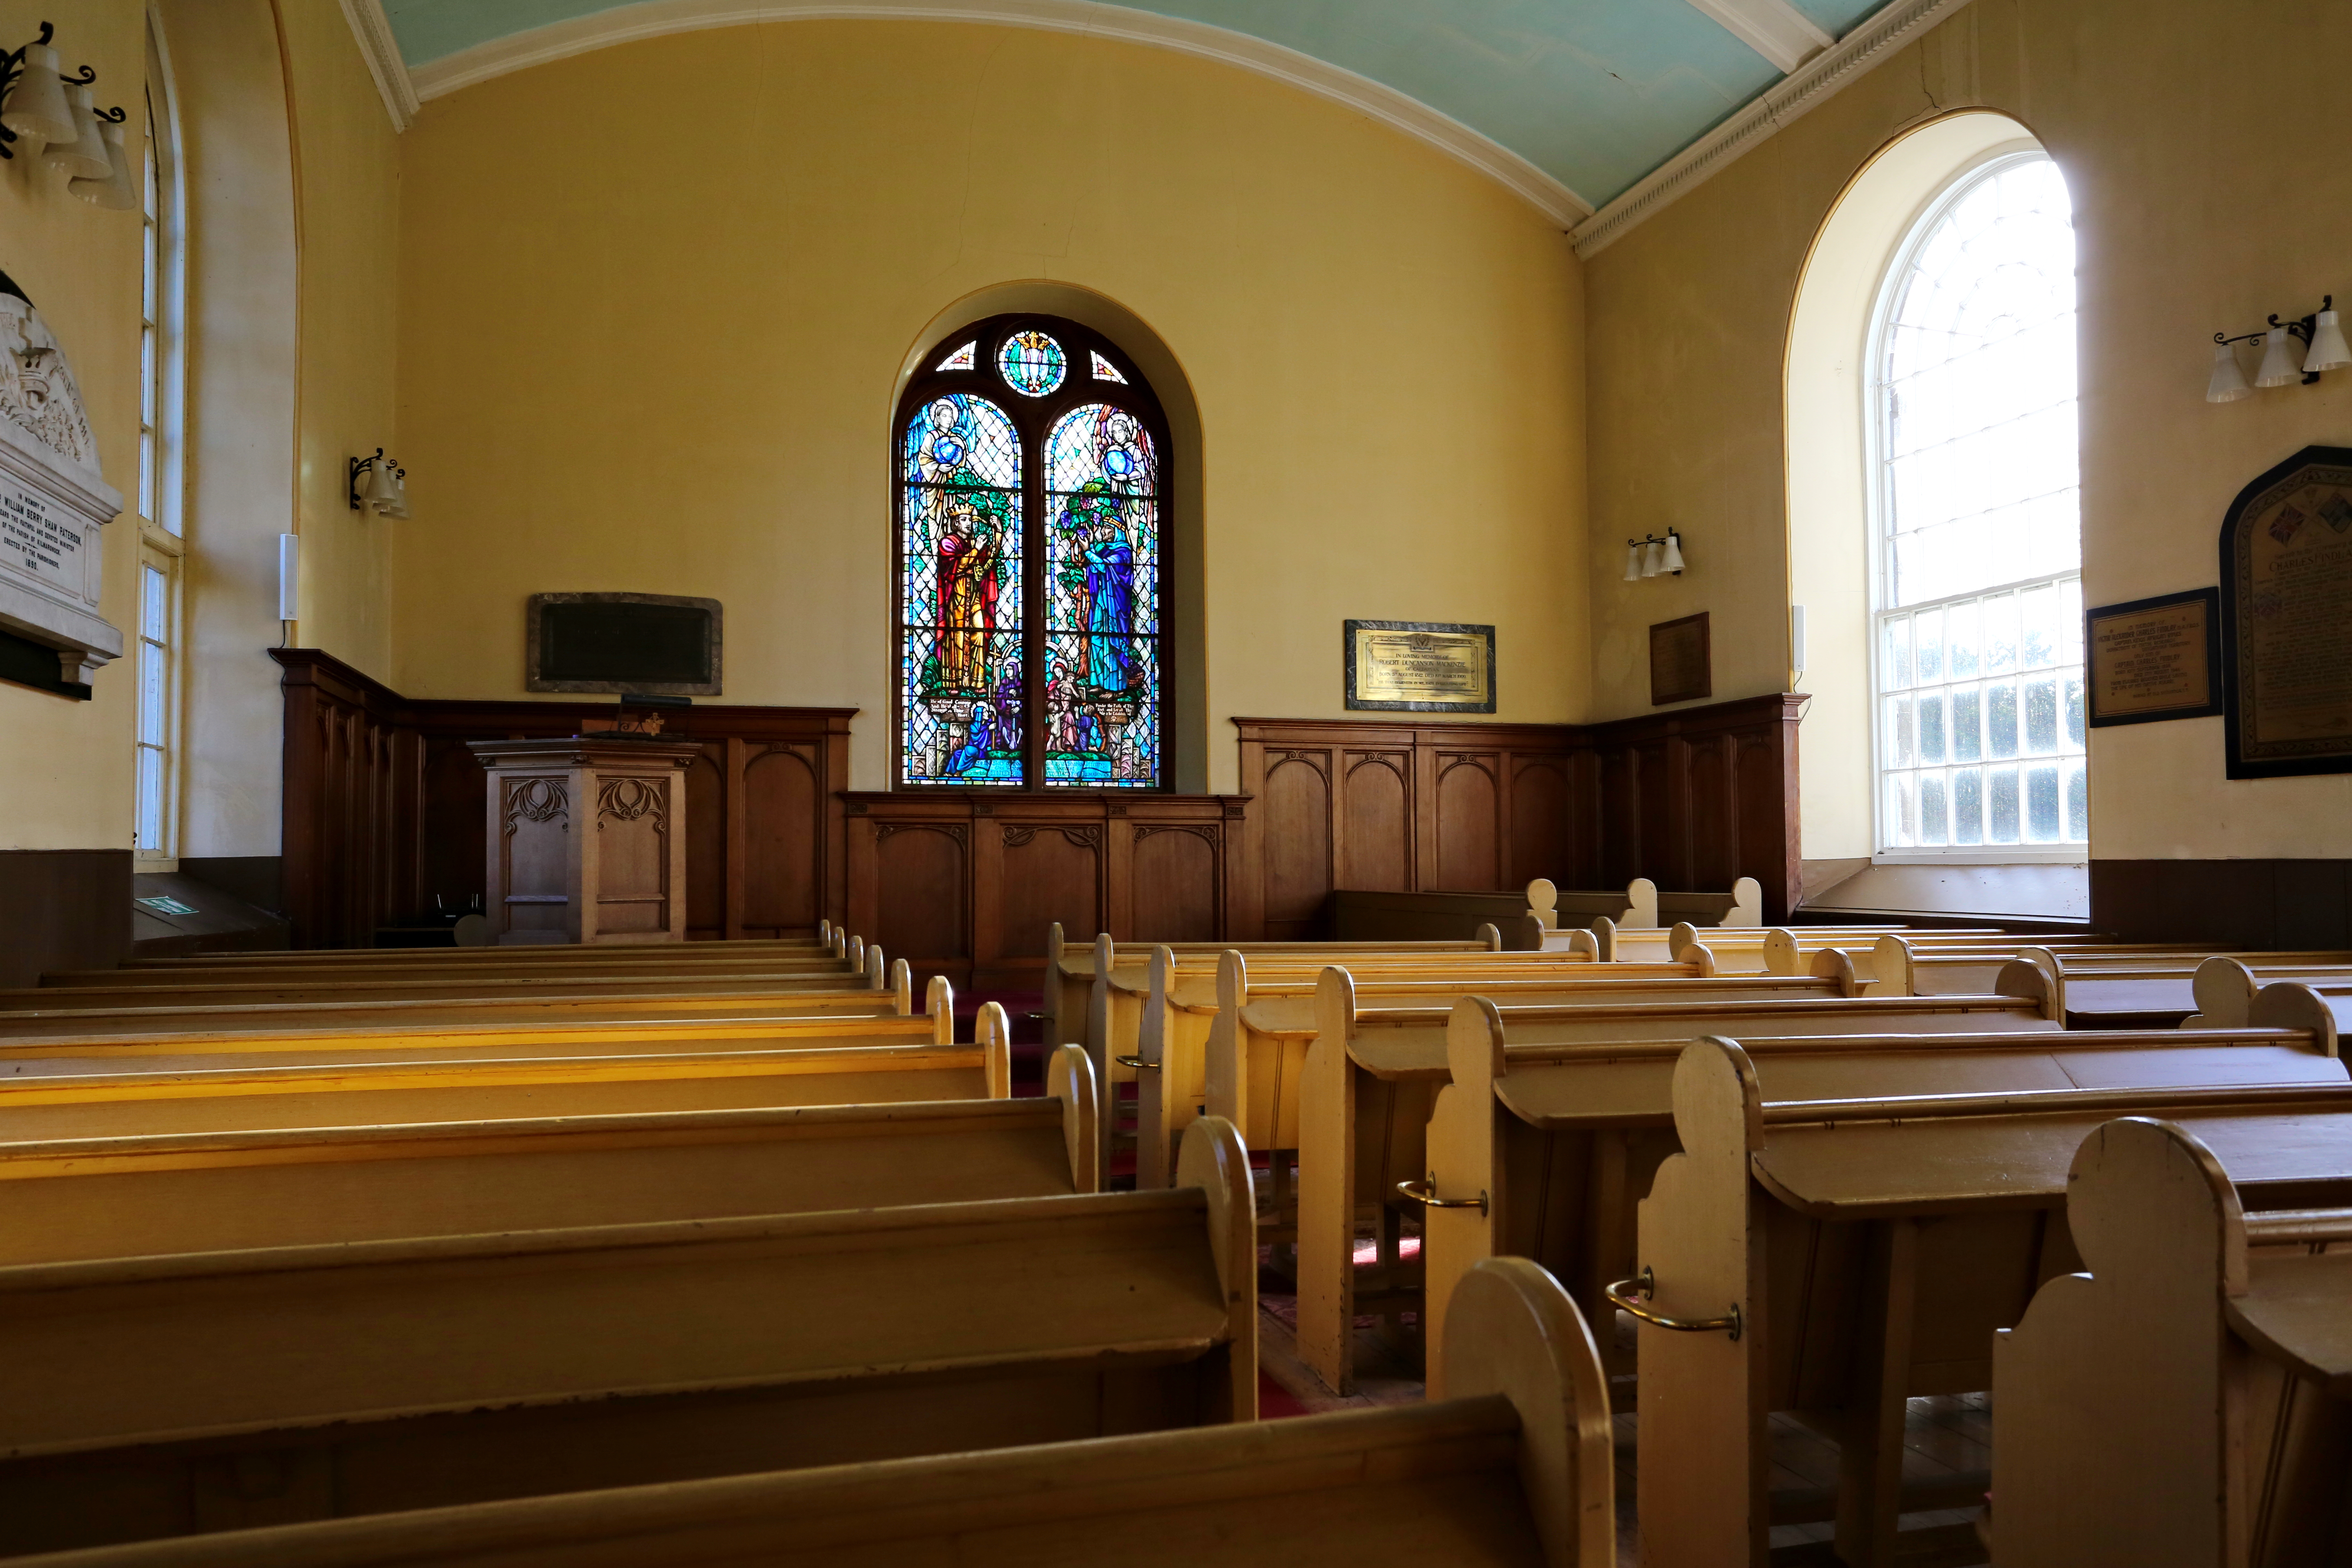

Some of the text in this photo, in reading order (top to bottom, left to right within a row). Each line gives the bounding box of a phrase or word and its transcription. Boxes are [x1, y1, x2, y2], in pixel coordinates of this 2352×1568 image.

[25, 497, 40, 509] MEMORY
[4, 497, 24, 515] WILLIAM
[27, 509, 42, 525] BERRY
[45, 519, 58, 532] SHAW
[60, 526, 82, 546] PATERSON,
[0, 509, 9, 518] EARS
[20, 519, 35, 532] FAITHFUL
[45, 532, 58, 543] DEVOTED
[60, 540, 74, 552] MINISTER
[17, 529, 29, 539] PARISH
[4, 537, 20, 550] ERECTED
[26, 558, 38, 571] 1890.
[2269, 557, 2314, 572] CHARLES
[2314, 550, 2352, 563] FINDLA
[2136, 628, 2155, 636] CHARLES
[2136, 657, 2157, 665] CHARLES
